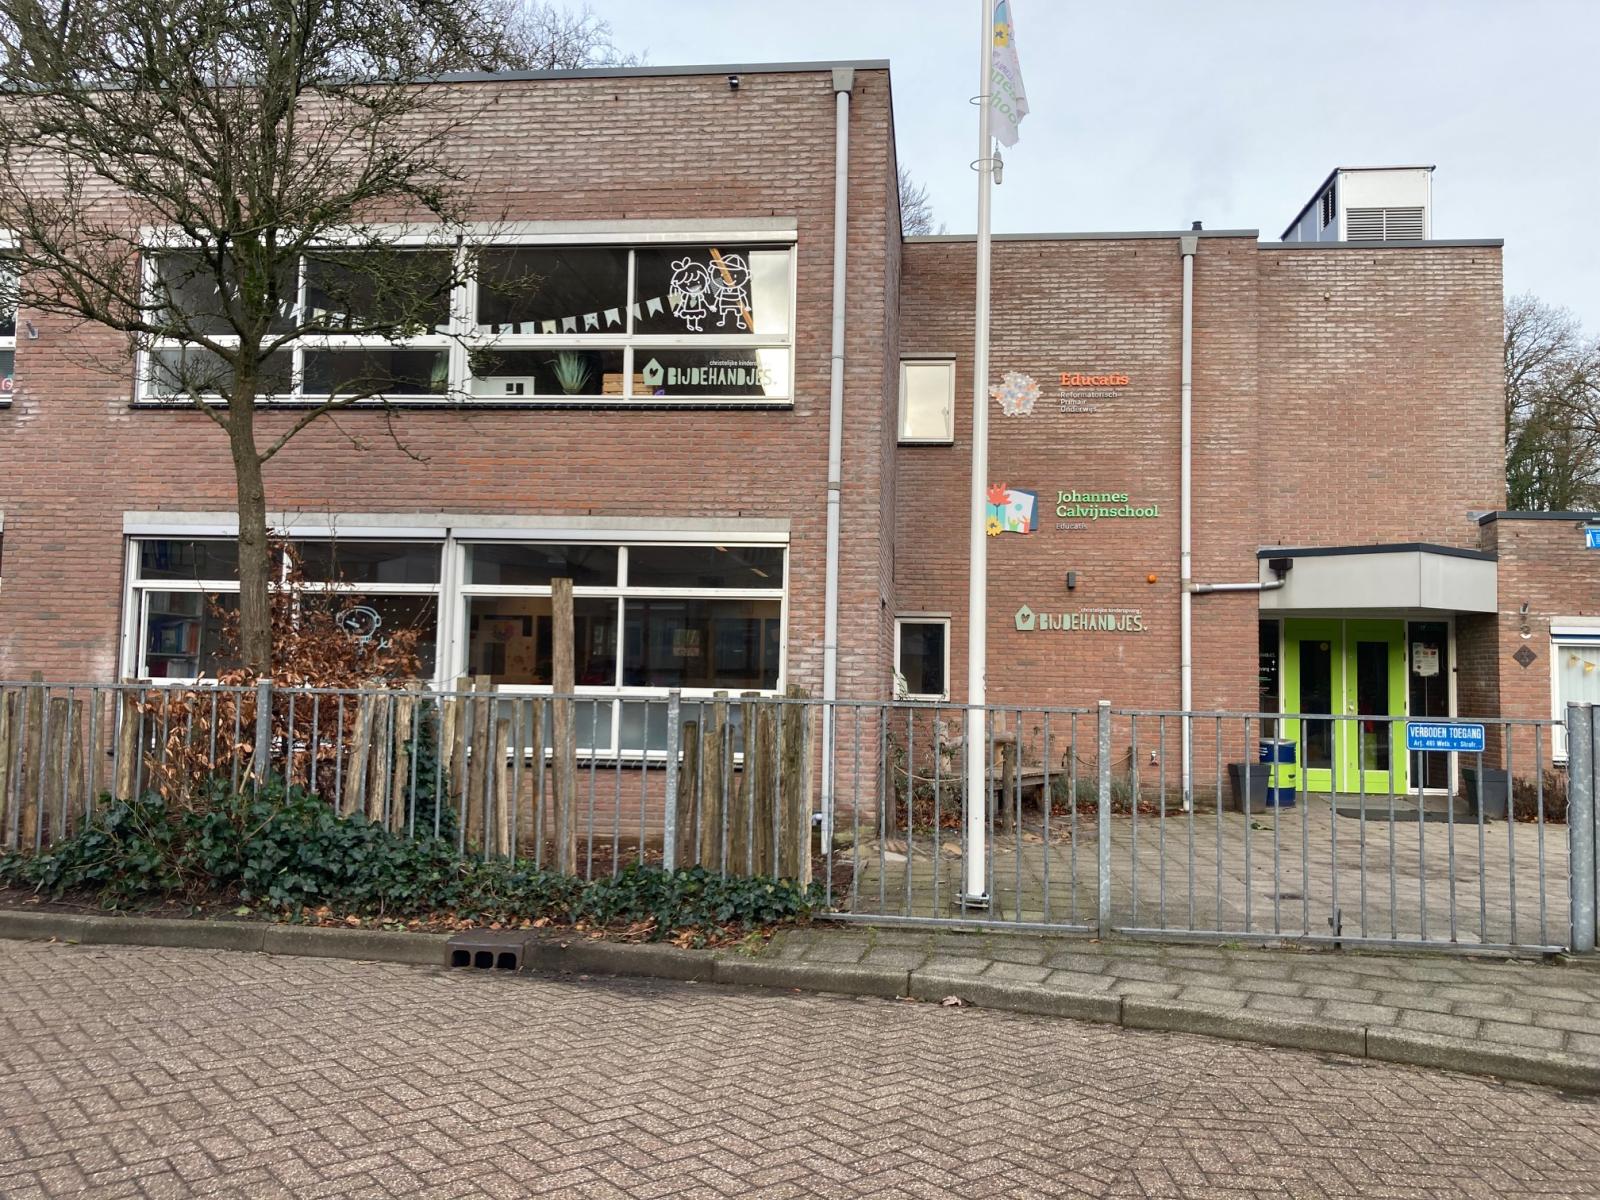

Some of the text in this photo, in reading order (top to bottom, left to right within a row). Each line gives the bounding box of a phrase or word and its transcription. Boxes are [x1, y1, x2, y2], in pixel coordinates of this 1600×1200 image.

[1060, 372, 1129, 386] Educatis
[1056, 490, 1129, 504] Johannes
[1056, 505, 1159, 520] Calvijnschool
[1409, 726, 1482, 739] VERBODEN TOEGANG
